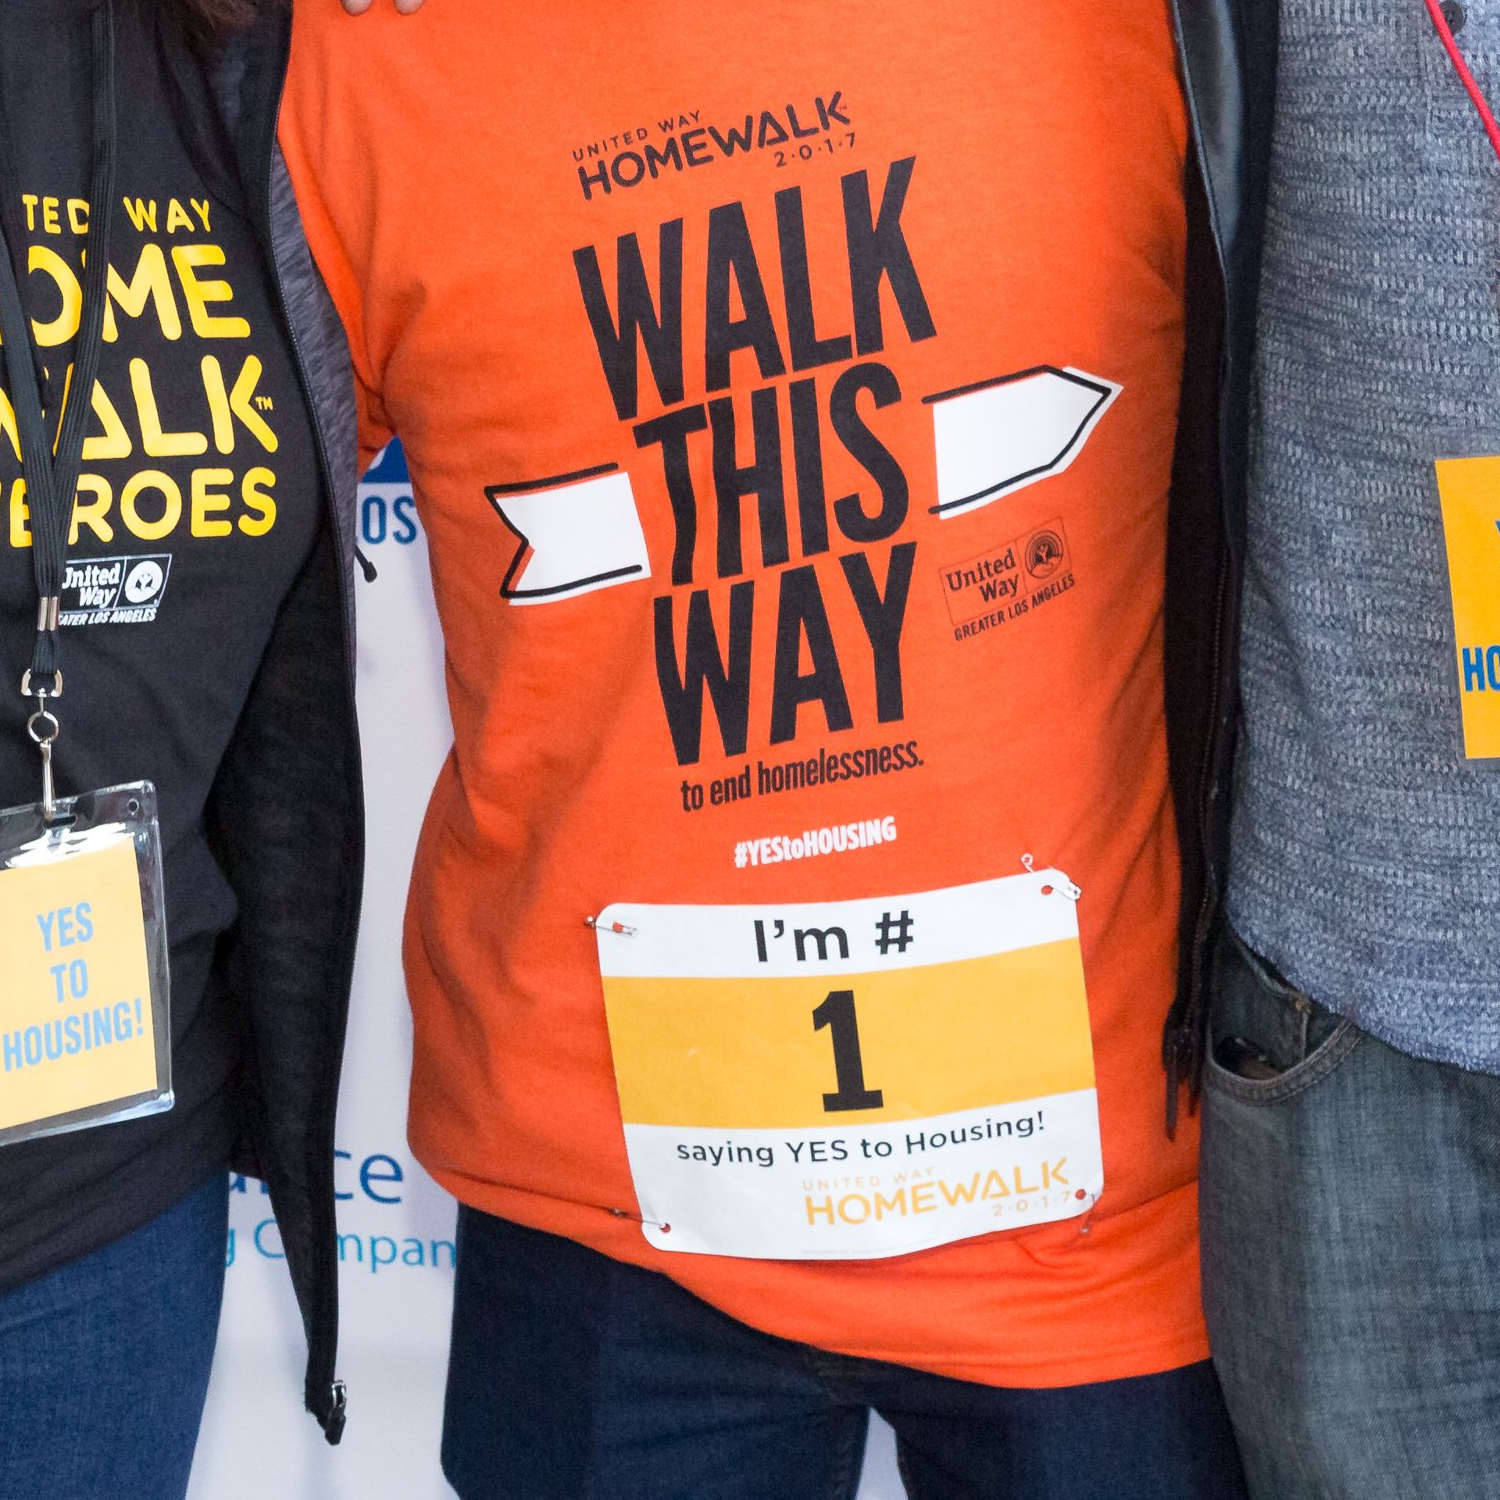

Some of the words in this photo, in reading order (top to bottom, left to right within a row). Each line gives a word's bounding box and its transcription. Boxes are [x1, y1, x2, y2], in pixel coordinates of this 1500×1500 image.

[572, 127, 648, 162] UNITED
[658, 110, 700, 133] WAY
[577, 90, 851, 201] HOMEWALK
[123, 195, 211, 234] WAY
[572, 154, 938, 421] WALK
[632, 362, 911, 586] THIS
[357, 495, 417, 544] OS
[946, 548, 1016, 591] United
[979, 573, 1020, 603] Way
[79, 586, 117, 609] Way
[88, 611, 111, 625] LOS
[110, 607, 157, 624] ANGELES
[954, 610, 1005, 642] GREATER
[1008, 599, 1029, 620] LOS
[1031, 573, 1076, 609] ANGELES
[652, 540, 918, 766] WAY
[680, 780, 704, 812] to
[709, 764, 751, 807] end
[757, 740, 924, 796] homelessness.
[733, 815, 897, 869] #YEStoHOUSING
[36, 901, 94, 953] YES
[49, 958, 89, 1004] TO
[2, 997, 145, 1073] HOUSING!
[811, 989, 885, 1113] 1
[676, 1140, 774, 1168] saying
[785, 1138, 849, 1164] YES
[861, 1137, 894, 1160] to
[905, 1110, 1047, 1156] Housing!
[802, 1175, 881, 1191] UNITED
[893, 1165, 936, 1185] WAY
[804, 1156, 1070, 1226] HOMEWALK
